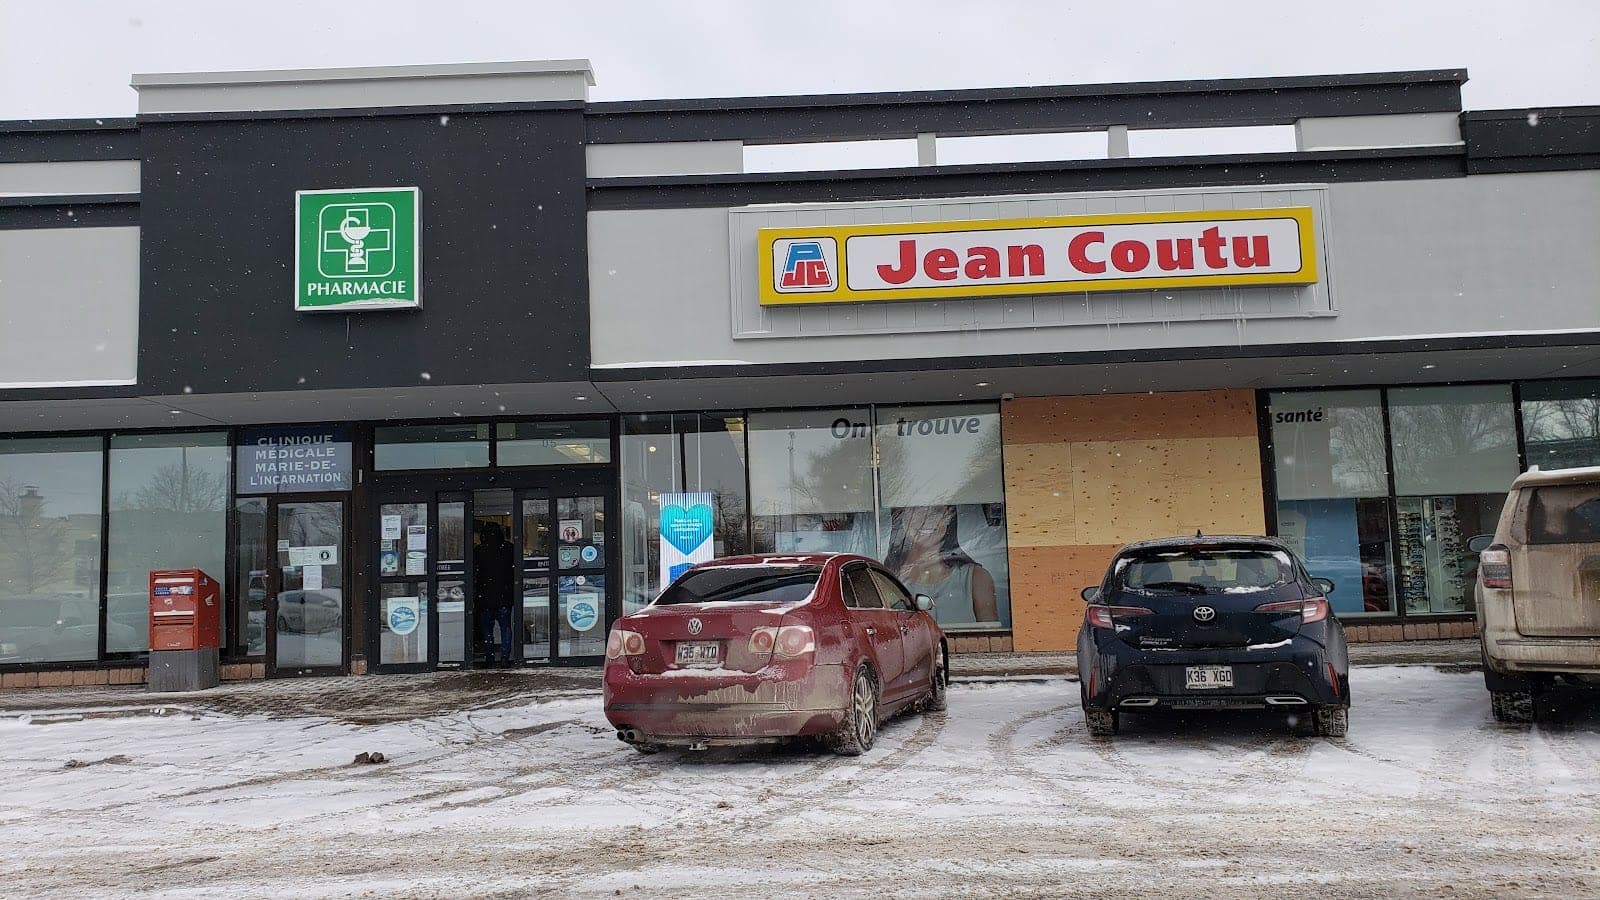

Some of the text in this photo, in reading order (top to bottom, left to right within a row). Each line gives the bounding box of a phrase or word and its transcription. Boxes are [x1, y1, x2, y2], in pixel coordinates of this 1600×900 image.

[876, 226, 1271, 285] Jean Coutu
[307, 281, 406, 296] PHARMACIE
[1275, 406, 1323, 424] santé
[831, 417, 981, 439] On trouve
[257, 435, 334, 447] CLINIQUE
[255, 446, 336, 460] MÉDICALE
[255, 460, 337, 473] MARIE-DE-
[250, 472, 342, 486] L'INCARNATION
[1187, 671, 1207, 683] K36
